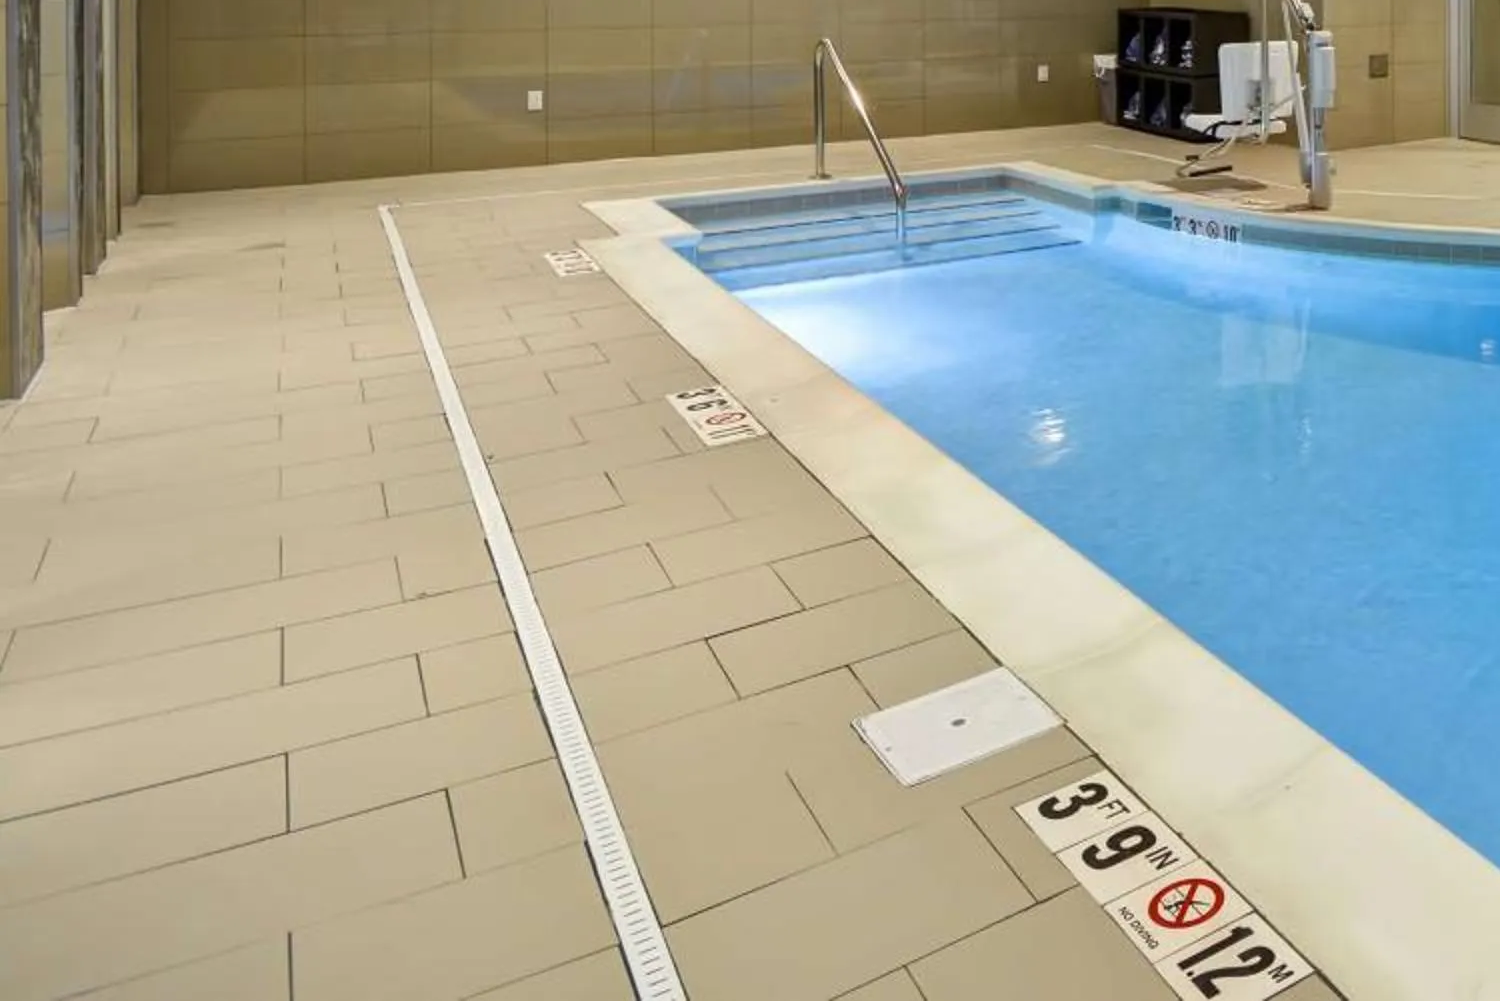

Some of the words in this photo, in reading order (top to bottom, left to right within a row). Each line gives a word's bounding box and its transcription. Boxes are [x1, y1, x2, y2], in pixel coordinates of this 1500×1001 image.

[1037, 782, 1109, 820] 3
[1097, 798, 1132, 820] FT
[1081, 824, 1157, 871] 9
[1145, 846, 1181, 871] IN
[1117, 906, 1134, 924] NO
[1130, 920, 1160, 950] DIVING
[1177, 925, 1276, 1000] 1.2
[1267, 964, 1295, 984] M
